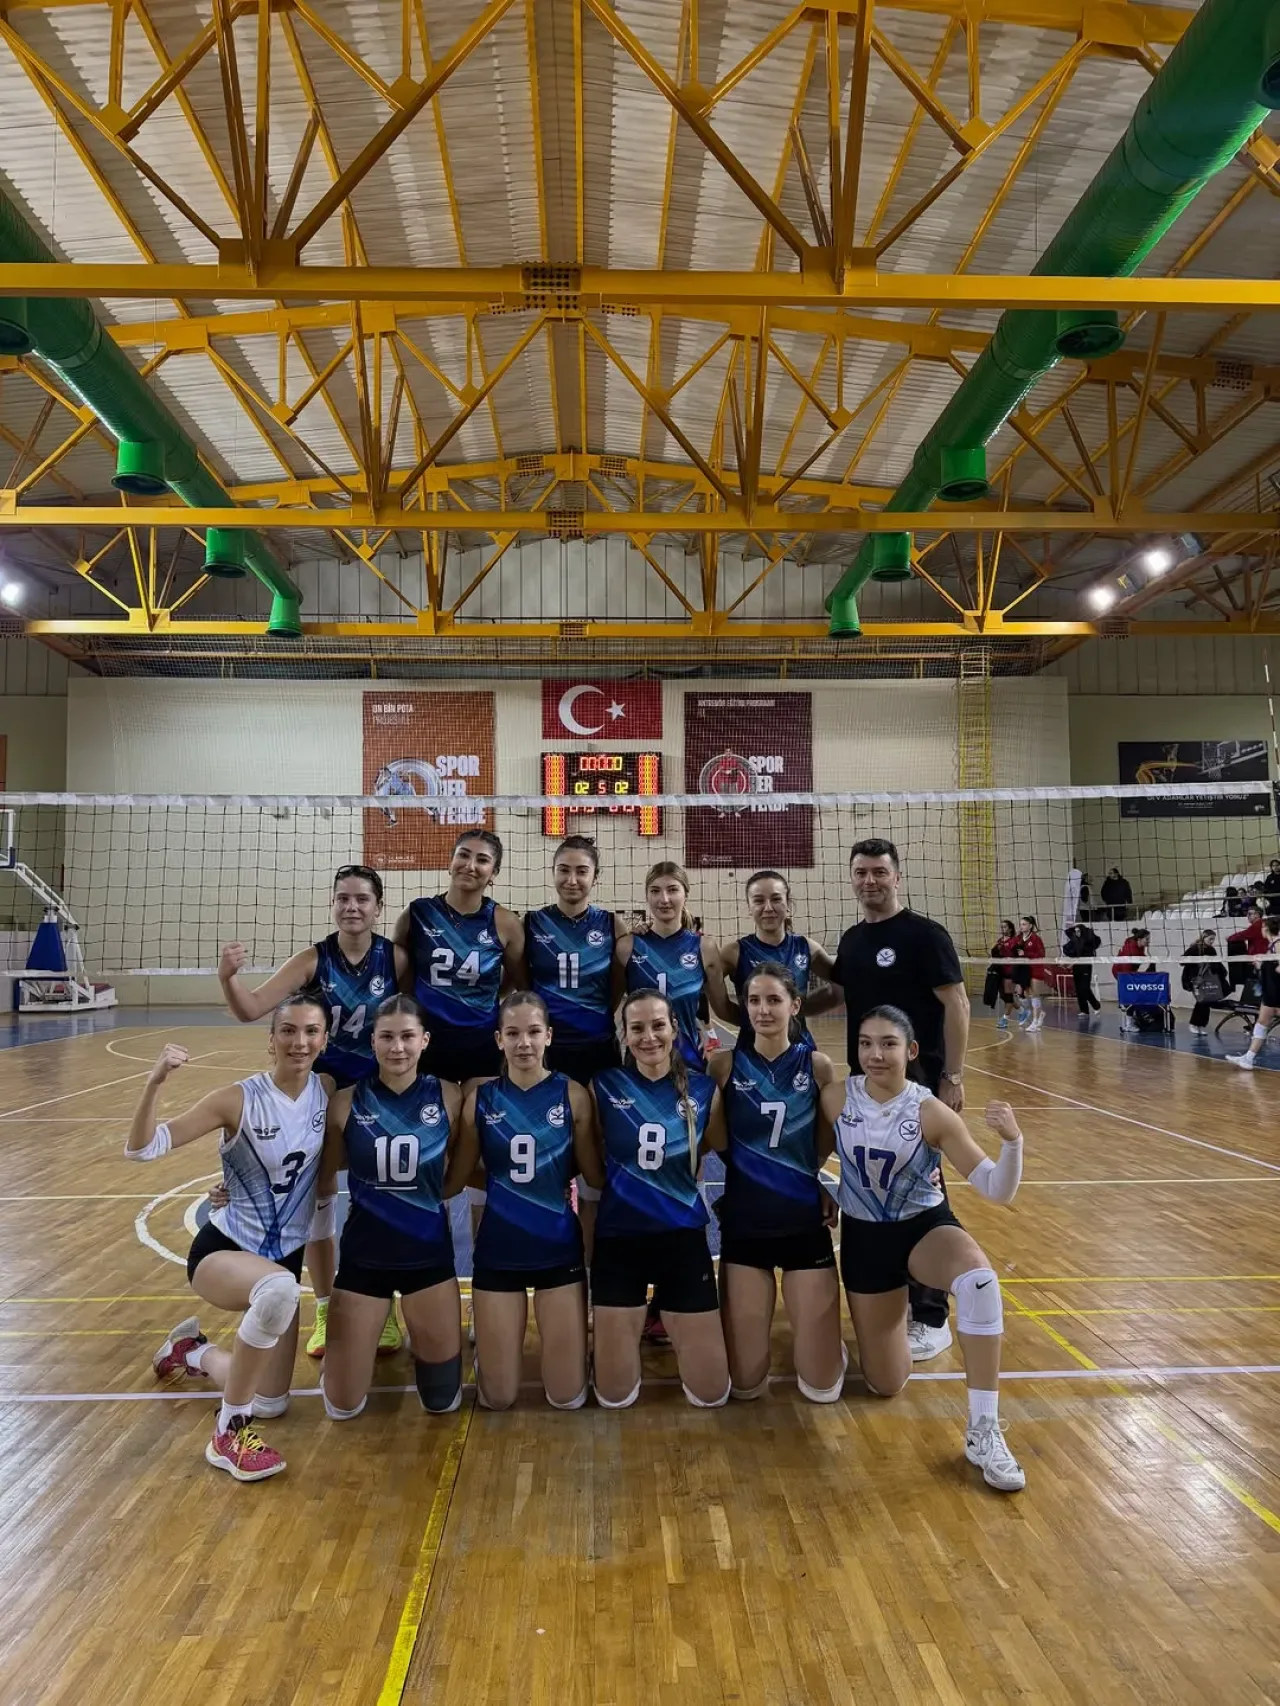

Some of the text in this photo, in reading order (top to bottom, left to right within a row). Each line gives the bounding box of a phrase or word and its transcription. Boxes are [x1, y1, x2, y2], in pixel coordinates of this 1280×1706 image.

[436, 755, 480, 777] SPOR
[749, 755, 784, 774] SPOR
[575, 781, 590, 795] 02
[614, 781, 629, 794] 02
[430, 948, 481, 987] 24
[557, 952, 580, 989] 11
[1126, 983, 1165, 992] avessa
[330, 1004, 367, 1039] 14
[760, 1101, 787, 1149] 7
[374, 1134, 420, 1183] 10
[509, 1134, 536, 1183] 9
[637, 1122, 666, 1170] 8
[270, 1150, 307, 1194] 3
[853, 1145, 897, 1191] 17
